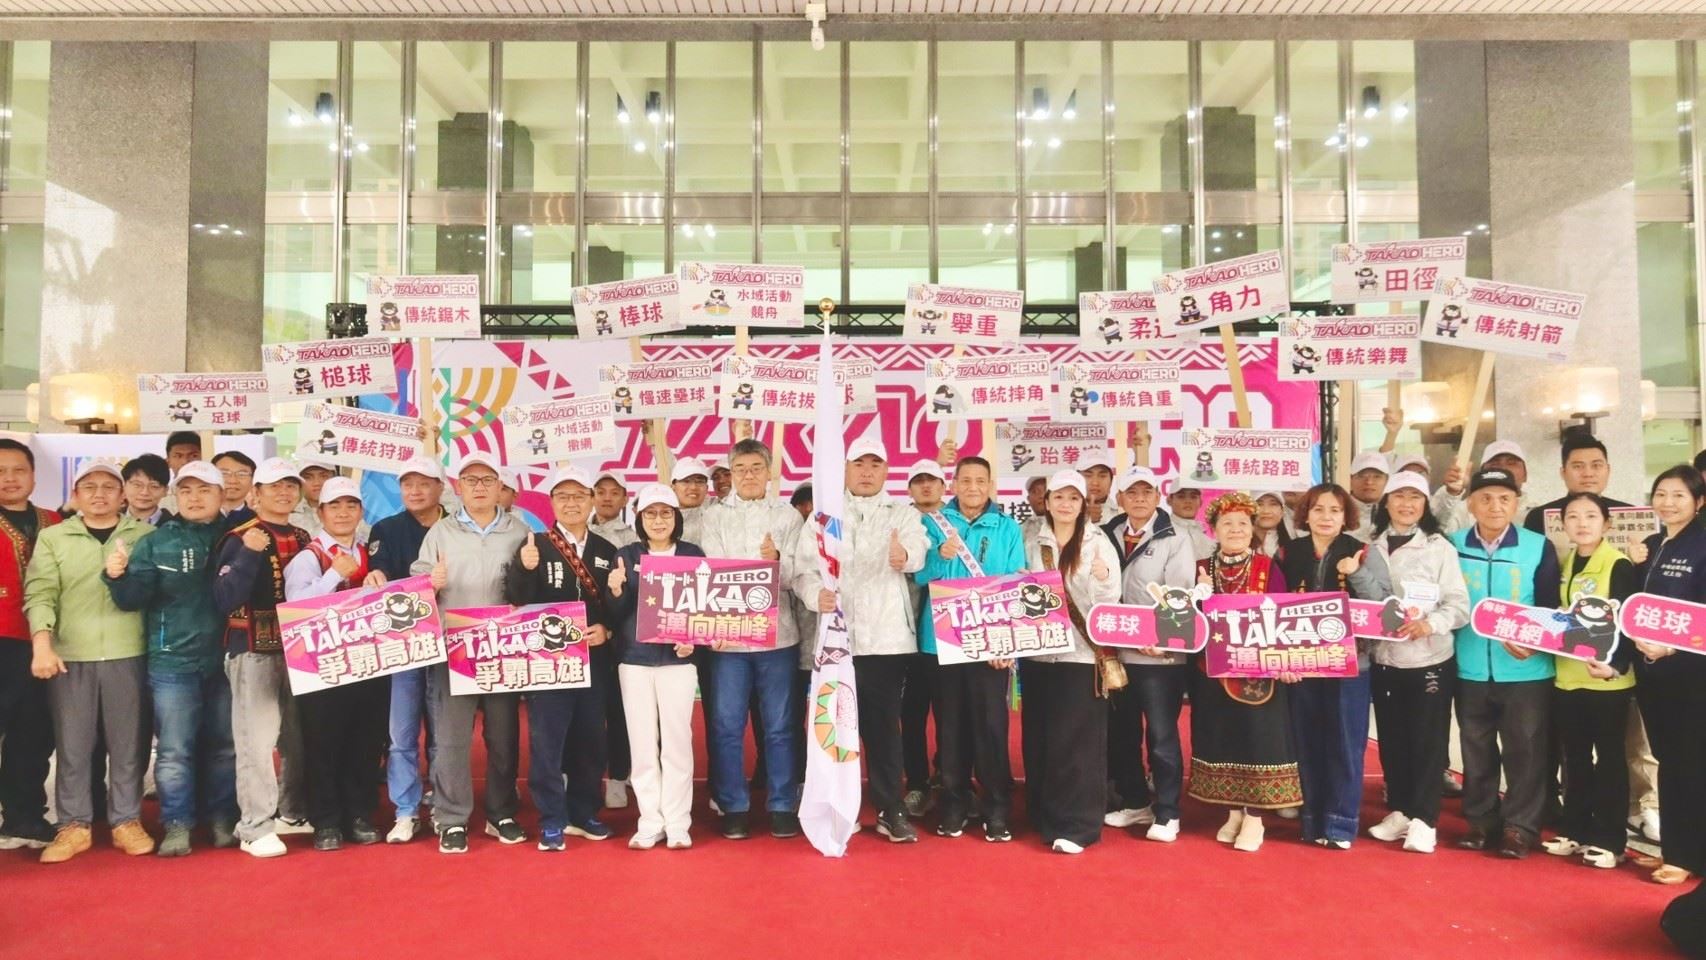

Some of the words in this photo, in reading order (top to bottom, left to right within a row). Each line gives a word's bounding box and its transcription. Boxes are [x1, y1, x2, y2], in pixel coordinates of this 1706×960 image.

[1365, 244, 1419, 261] TAKAO
[1420, 243, 1465, 258] HERO
[712, 267, 764, 284] TAKAO
[765, 272, 803, 285] HERO
[1185, 265, 1240, 289] TAKAO
[1240, 257, 1280, 279] HERO
[1385, 266, 1438, 291] 田徑
[394, 279, 441, 297] TAKAO
[441, 282, 478, 296] HERO
[599, 283, 645, 303] TAKAO
[645, 279, 680, 296] HERO
[737, 289, 792, 303] 水域活動
[936, 289, 984, 307] TAKAO
[983, 295, 1021, 310] HERO
[1208, 285, 1261, 315] 角力
[1470, 284, 1532, 308] TAKAO
[1531, 296, 1583, 316] HERO
[405, 305, 471, 324] 傳統鋸木
[619, 301, 664, 328] 棒球
[751, 306, 778, 320] 競舟
[950, 311, 999, 337] 舉重
[1312, 320, 1372, 338] TAKAO
[1372, 321, 1418, 336] HERO
[1476, 314, 1564, 345] 傳統射箭
[297, 343, 350, 361] TAKAO
[350, 341, 392, 358] HERO
[1326, 347, 1409, 365] 傳統樂舞
[320, 363, 373, 389] 槌球
[628, 364, 676, 381] TAKAO
[676, 365, 713, 379] HERO
[847, 364, 873, 377] ERO
[956, 361, 1009, 379] TAKAO
[1009, 359, 1050, 376] HERO
[1088, 367, 1140, 383] TAKAO
[1140, 367, 1179, 381] HERO
[171, 378, 227, 394] TAKAO
[227, 377, 269, 391] HERO
[971, 384, 1044, 405] 傳統摔角
[203, 394, 248, 409] 五人制
[639, 386, 706, 407] 慢速壘球
[761, 387, 817, 410] 傳統拔
[1101, 390, 1173, 408] 傳統負重
[211, 410, 241, 425] 足球
[530, 403, 576, 425] TAKAO
[576, 401, 611, 418] HERO
[388, 421, 418, 437] HER
[554, 419, 603, 437] 水域活動
[1022, 424, 1070, 440] TAKAO
[1071, 426, 1106, 438] HERO
[342, 436, 415, 462] 傳統狩獵
[1213, 432, 1267, 450] TAKAO
[1268, 436, 1311, 450] HERO
[1040, 445, 1101, 465] 跆拳
[1222, 458, 1300, 477] 傳統路跑
[720, 570, 769, 582] HERO
[986, 589, 1020, 602] HERO
[345, 602, 385, 619] HERO
[1286, 602, 1339, 615] HERO
[503, 620, 540, 635] HERO
[657, 609, 772, 641] 邁向巔峰
[1096, 613, 1140, 636] 棒球
[1633, 603, 1693, 635] 槌球
[961, 622, 1069, 660] 爭霸高雄
[318, 633, 440, 685] 爭霸高雄
[1225, 644, 1348, 673] 邁向巔峰
[475, 657, 585, 692] 爭霸高雄
